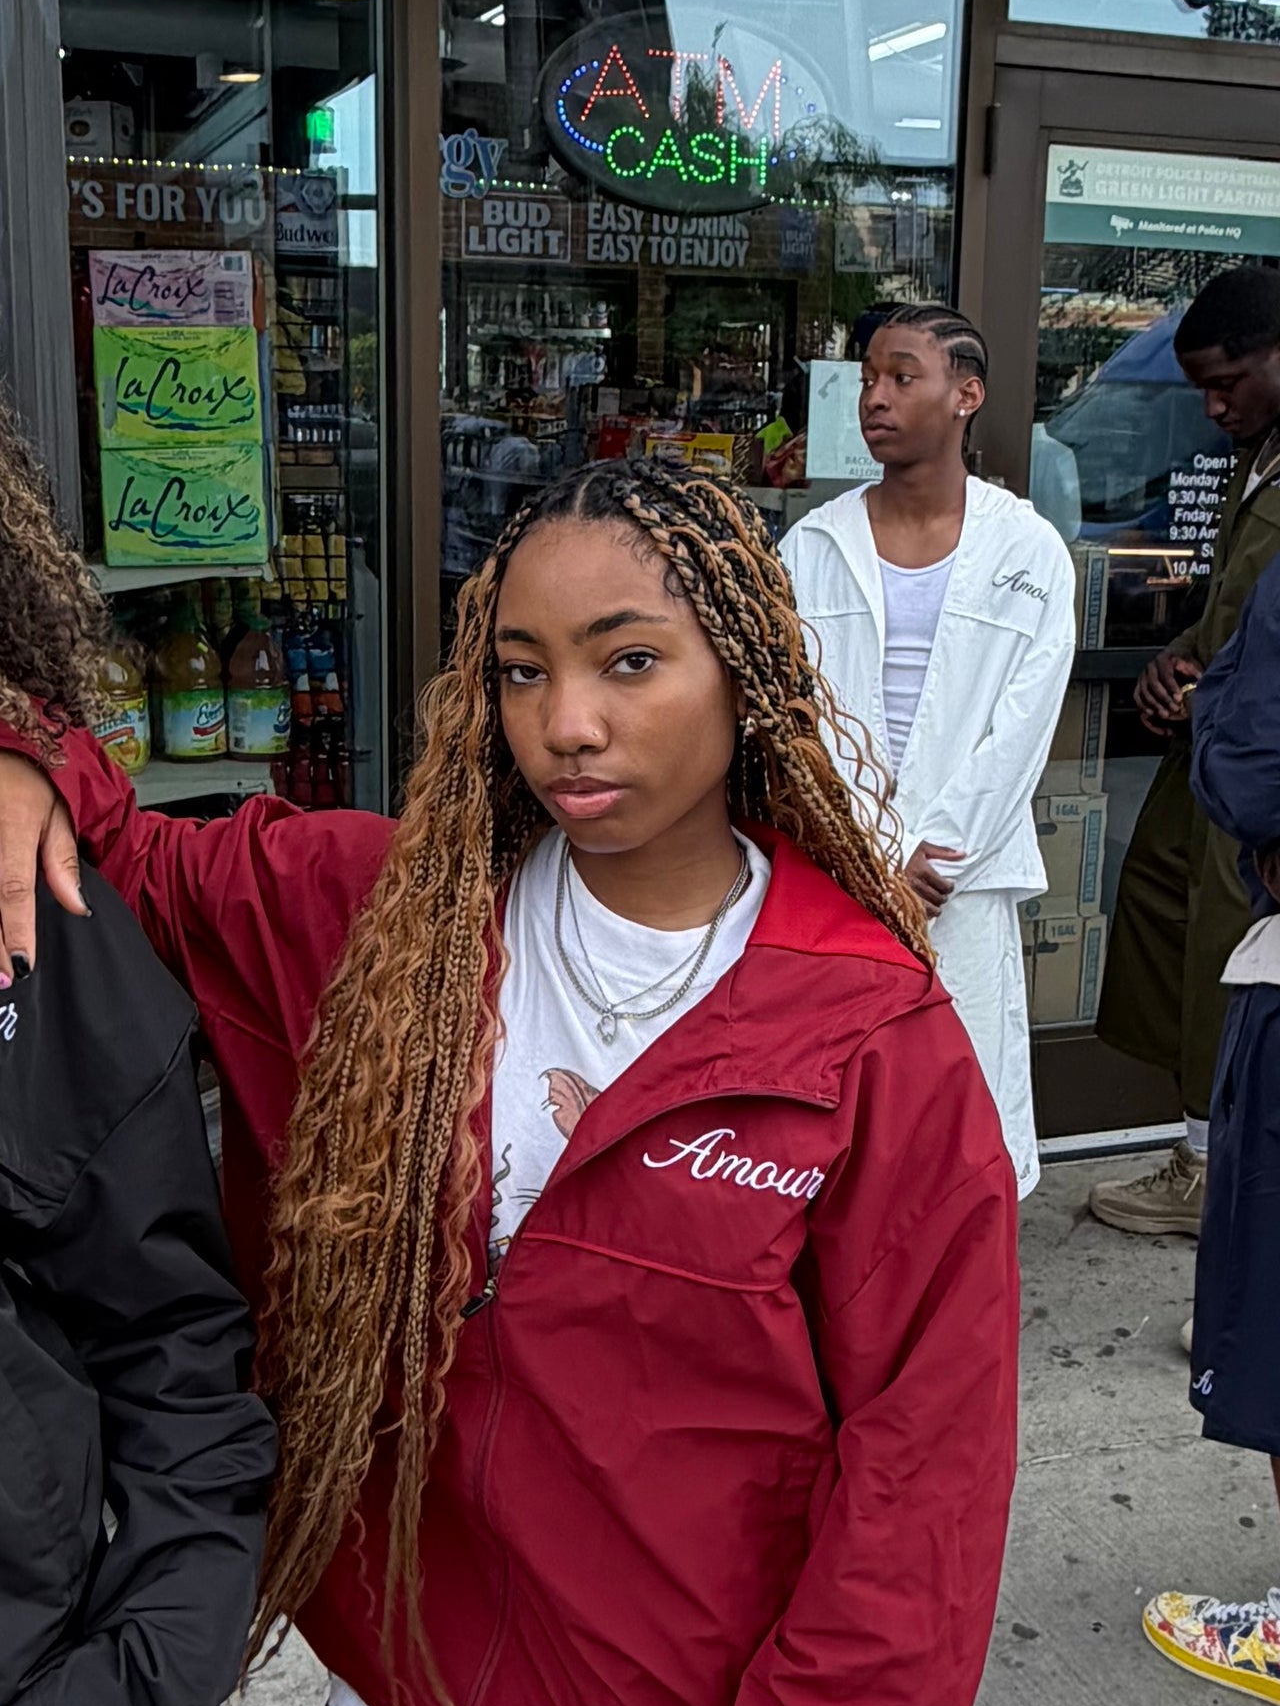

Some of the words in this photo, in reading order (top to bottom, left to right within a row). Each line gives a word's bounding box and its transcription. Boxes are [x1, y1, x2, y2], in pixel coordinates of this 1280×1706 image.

[580, 44, 782, 139] ATM
[440, 128, 508, 198] gy
[605, 125, 768, 186] CASH
[116, 182, 187, 222] FOR
[1095, 180, 1154, 199] GREEN
[1158, 184, 1209, 203] LIGHT
[482, 200, 551, 230] BUD
[587, 202, 643, 234] EASY
[468, 226, 563, 257] LIGHT
[1224, 225, 1242, 240] HQ
[586, 233, 642, 263] EASY
[649, 235, 678, 266] TO
[680, 237, 750, 268] ENJOY
[1193, 454, 1227, 470] Open
[1170, 471, 1220, 490] Monday
[108, 475, 254, 538] LaCroix
[1197, 490, 1219, 505] Am
[1169, 526, 1197, 540] 9:30
[1173, 562, 1187, 574] 10
[1189, 561, 1210, 575] Am
[642, 1127, 826, 1200] Amour
